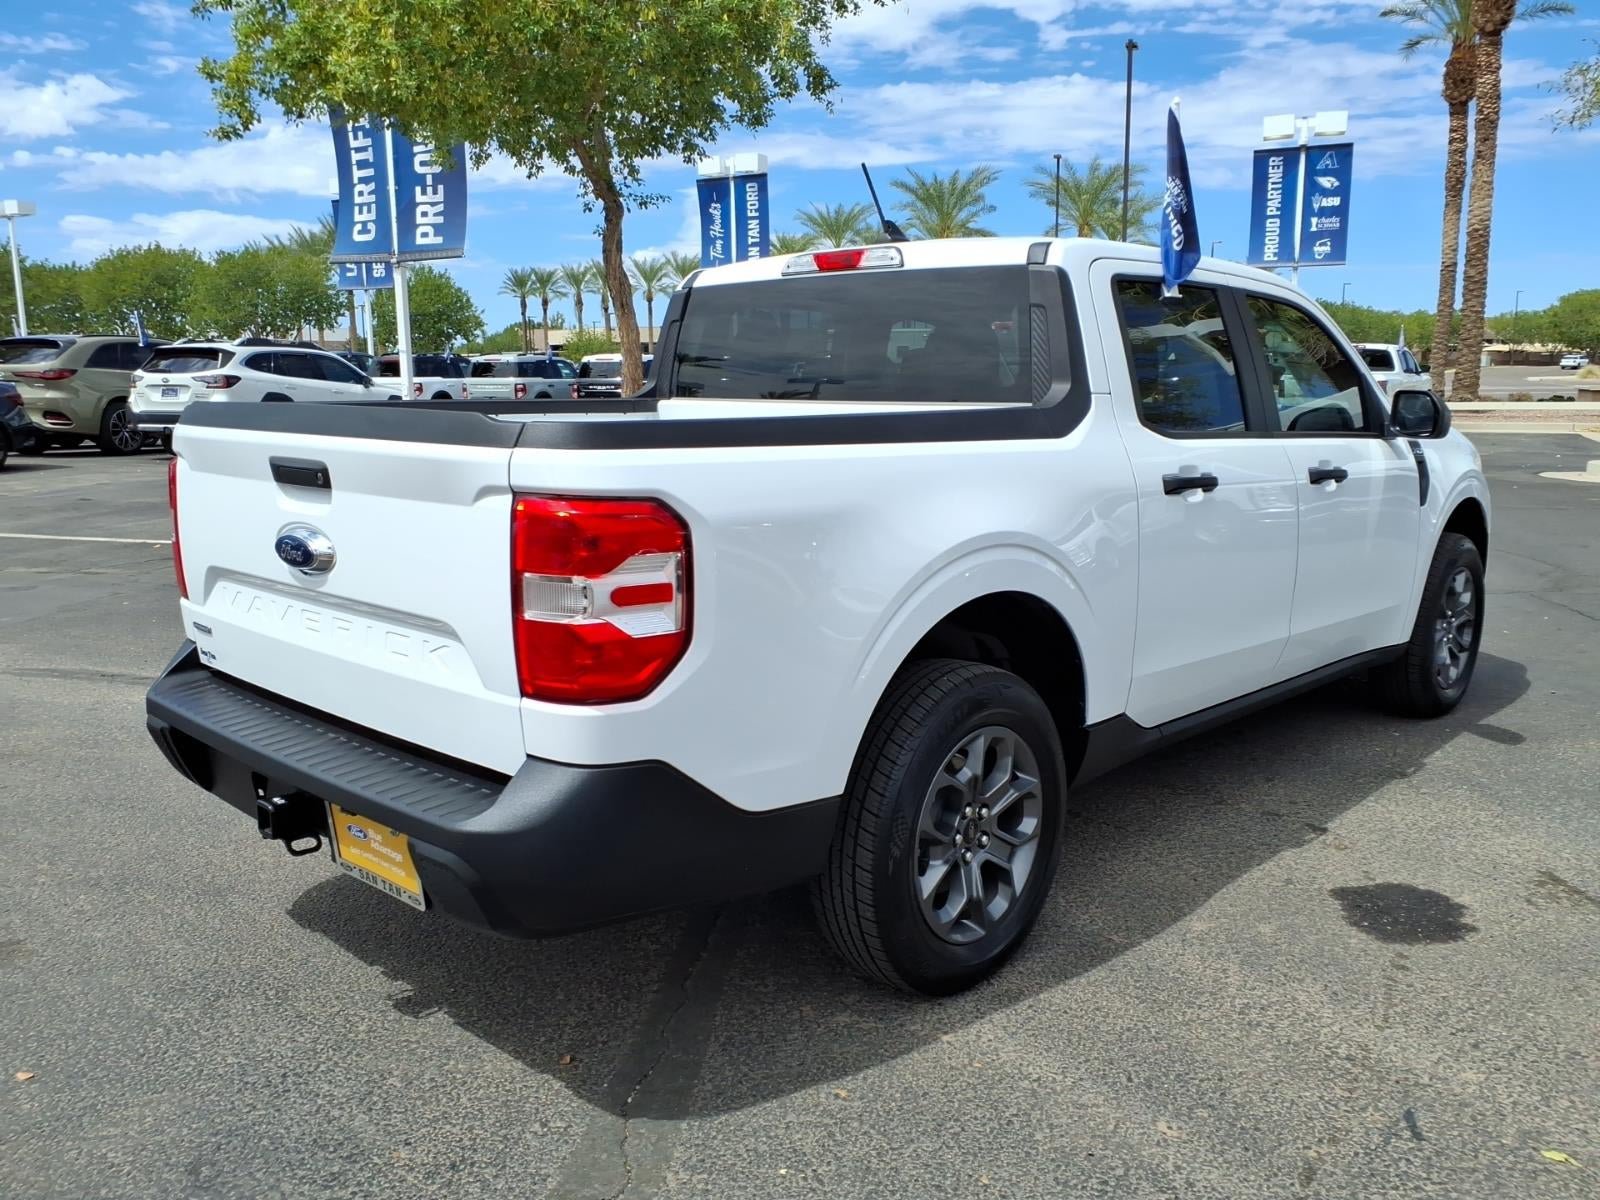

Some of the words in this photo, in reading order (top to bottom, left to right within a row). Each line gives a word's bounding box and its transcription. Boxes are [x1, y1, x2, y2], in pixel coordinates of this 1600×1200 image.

[347, 116, 376, 242] CERTIFI
[1266, 156, 1284, 215] PARTNER
[746, 182, 759, 217] FORD
[1321, 196, 1341, 207] ASU
[747, 219, 760, 244] TAN
[1264, 218, 1281, 261] PROUD
[710, 239, 725, 261] Tim
[280, 541, 304, 562] Ford
[381, 879, 401, 898] TAN
